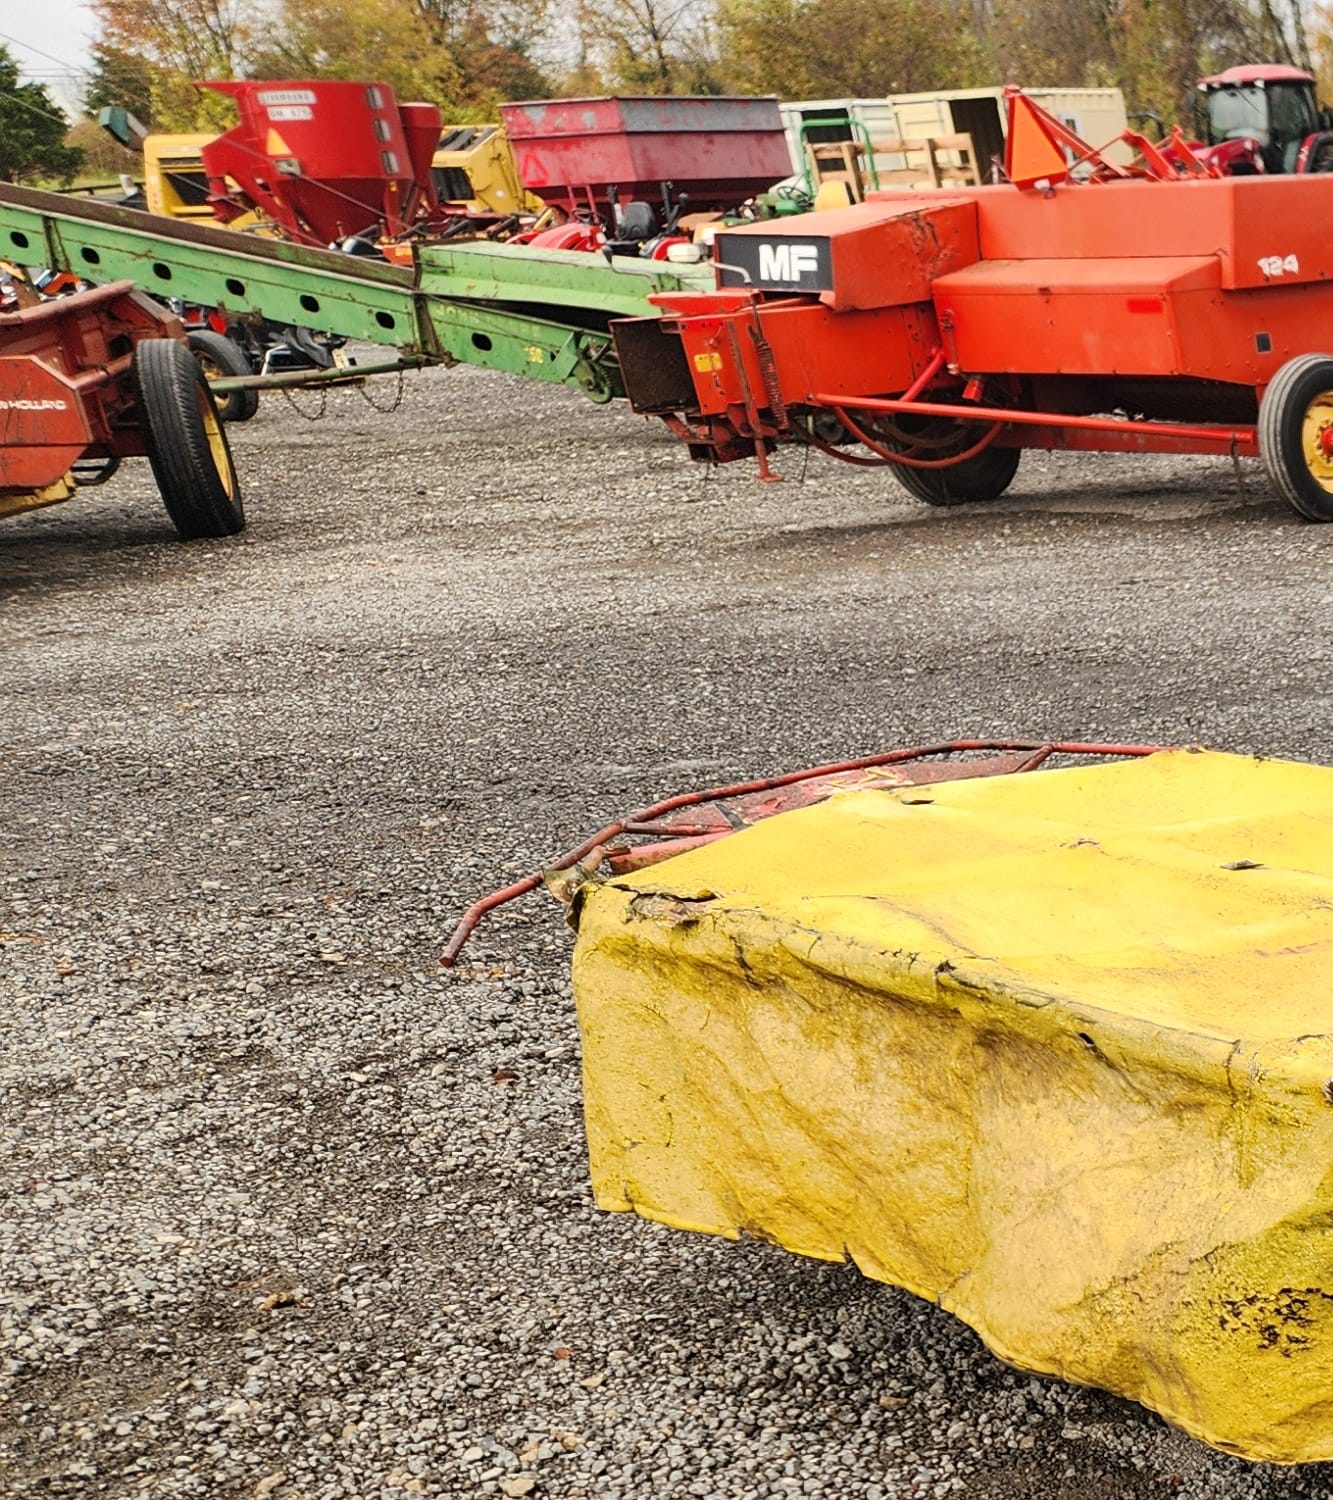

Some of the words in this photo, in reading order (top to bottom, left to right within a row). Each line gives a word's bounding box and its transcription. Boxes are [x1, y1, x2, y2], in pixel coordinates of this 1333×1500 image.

[759, 244, 818, 281] MF
[1257, 254, 1299, 276] 124
[8, 400, 67, 410] HOLLAND
